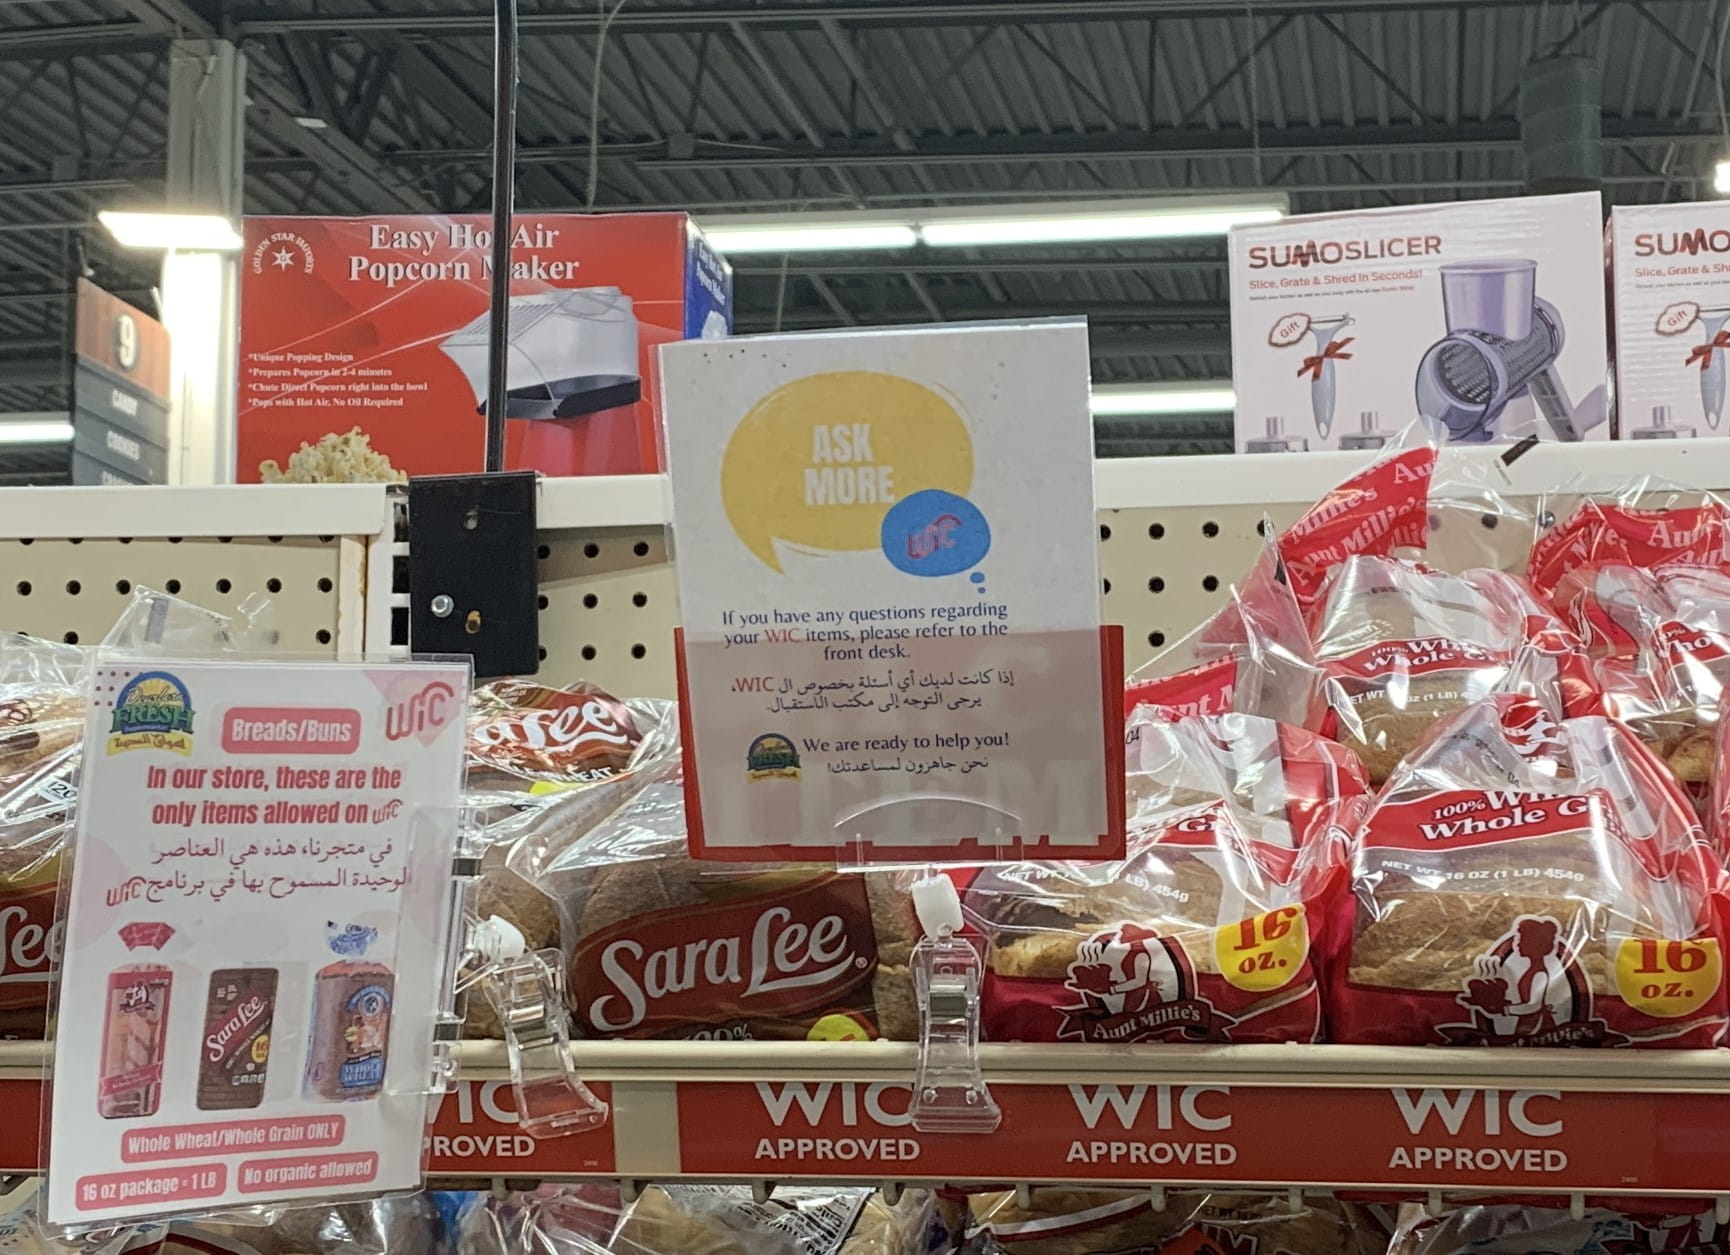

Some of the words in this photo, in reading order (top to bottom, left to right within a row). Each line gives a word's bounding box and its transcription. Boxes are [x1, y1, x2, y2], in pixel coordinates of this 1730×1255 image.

[370, 223, 438, 256] Easy
[448, 224, 493, 249] Ho
[510, 224, 560, 249] Air
[1249, 235, 1442, 269] SUMOSLICER
[253, 238, 271, 275] GOLDEN
[271, 232, 295, 243] STAR
[348, 255, 471, 288] Popcorn
[1280, 277, 1311, 288] Grate
[1324, 274, 1357, 285] Shred
[1359, 273, 1369, 282] In
[1371, 268, 1424, 281] Seconds!
[1667, 266, 1699, 276] Grate
[1280, 322, 1300, 338] Gift
[1667, 310, 1688, 327] Gift
[118, 314, 137, 368] 9
[287, 353, 323, 363] Popping
[325, 353, 353, 363] Design
[293, 368, 330, 378] Popcorn
[342, 368, 356, 377] 2-4
[358, 368, 392, 377] minutes
[310, 383, 346, 393] Popcorn
[348, 382, 370, 393] right
[372, 383, 389, 392] into
[390, 382, 405, 391] the
[406, 382, 428, 392] bowl
[275, 398, 295, 407] with
[296, 398, 313, 407] Hot
[333, 398, 345, 407] No
[347, 398, 362, 407] Oil
[363, 398, 404, 408] Required
[812, 423, 874, 464] ASK
[804, 465, 896, 506] MORE
[722, 611, 736, 626] If
[739, 612, 768, 628] you
[773, 609, 810, 625] have
[816, 610, 844, 626] any
[849, 605, 926, 625] questions
[930, 602, 1008, 621] regarding
[724, 631, 760, 648] your
[764, 629, 802, 644] WIC
[805, 627, 855, 644] items,
[859, 624, 911, 644] please
[914, 623, 952, 639] refer
[959, 623, 977, 638] to
[981, 622, 1008, 637] the
[824, 645, 864, 661] front
[868, 643, 911, 660] desk.
[779, 677, 793, 694] ال
[798, 677, 854, 696] بخصوص
[859, 670, 893, 689] أسئلة
[897, 670, 916, 692] أي
[919, 671, 955, 688] لديك
[958, 669, 993, 685] كانت
[998, 670, 1014, 684] إذا
[832, 692, 874, 708] مكتب
[878, 694, 899, 712] إلى
[902, 692, 943, 708] التوجه
[947, 694, 982, 710] يرجى
[109, 703, 196, 735] FRESH
[231, 718, 353, 744] Breads/Buns
[803, 739, 830, 753] We
[835, 741, 861, 752] are
[864, 736, 908, 754] ready
[914, 736, 931, 748] to
[935, 733, 970, 752] help
[974, 732, 1010, 750] you!
[147, 766, 166, 789] In
[172, 768, 206, 789] our
[211, 767, 270, 793] store,
[276, 764, 330, 789] these
[334, 768, 366, 789] are
[371, 764, 402, 788] the
[906, 760, 955, 775] جاهزون
[960, 758, 989, 773] نحن
[152, 800, 196, 828] only
[201, 799, 258, 825] items
[263, 798, 339, 825] allowed
[344, 803, 368, 824] on
[1432, 798, 1487, 821] 100%
[1419, 810, 1547, 841] Whole
[151, 838, 225, 864] العناصر
[229, 844, 258, 871] هي
[264, 838, 297, 856] هذه
[369, 839, 393, 868] في
[242, 869, 264, 893] بها
[268, 867, 347, 898] المسموح
[351, 866, 412, 892] الوحيدة
[1382, 859, 1411, 871] NET
[1416, 865, 1443, 878] WT
[1468, 869, 1489, 880] OZ
[1513, 867, 1541, 879] LB)
[1544, 867, 1585, 883] 454g
[146, 870, 205, 904] برنامج
[209, 872, 236, 902] في
[1153, 884, 1190, 904] 454g
[1232, 907, 1298, 952] 16
[589, 938, 742, 1033] Sara
[740, 906, 856, 998] Lee
[1238, 955, 1288, 975] oz.
[1633, 938, 1708, 975] 16
[1640, 982, 1695, 999] oz.
[206, 1016, 242, 1063] Sara
[238, 996, 266, 1028] Lee
[1092, 1019, 1138, 1041] Aunt
[1140, 1004, 1202, 1032] Millie's
[754, 1082, 915, 1128] WIC
[1067, 1084, 1233, 1131] WIC
[1390, 1088, 1564, 1137] WIC
[128, 1136, 171, 1155] Whole
[174, 1129, 266, 1151] Wheat/Whole
[268, 1125, 304, 1144] Grain
[306, 1119, 341, 1140] ONLY
[754, 1137, 921, 1162] APPROVED
[1066, 1141, 1238, 1166] APPROVED
[1388, 1147, 1569, 1173] APPROVED
[244, 1166, 262, 1186] No
[264, 1161, 316, 1184] organic
[318, 1158, 372, 1179] allowed
[82, 1184, 98, 1201] 16
[100, 1184, 117, 1199] oz
[120, 1177, 179, 1200] package
[191, 1172, 199, 1189] 1
[200, 1170, 217, 1188] LB
